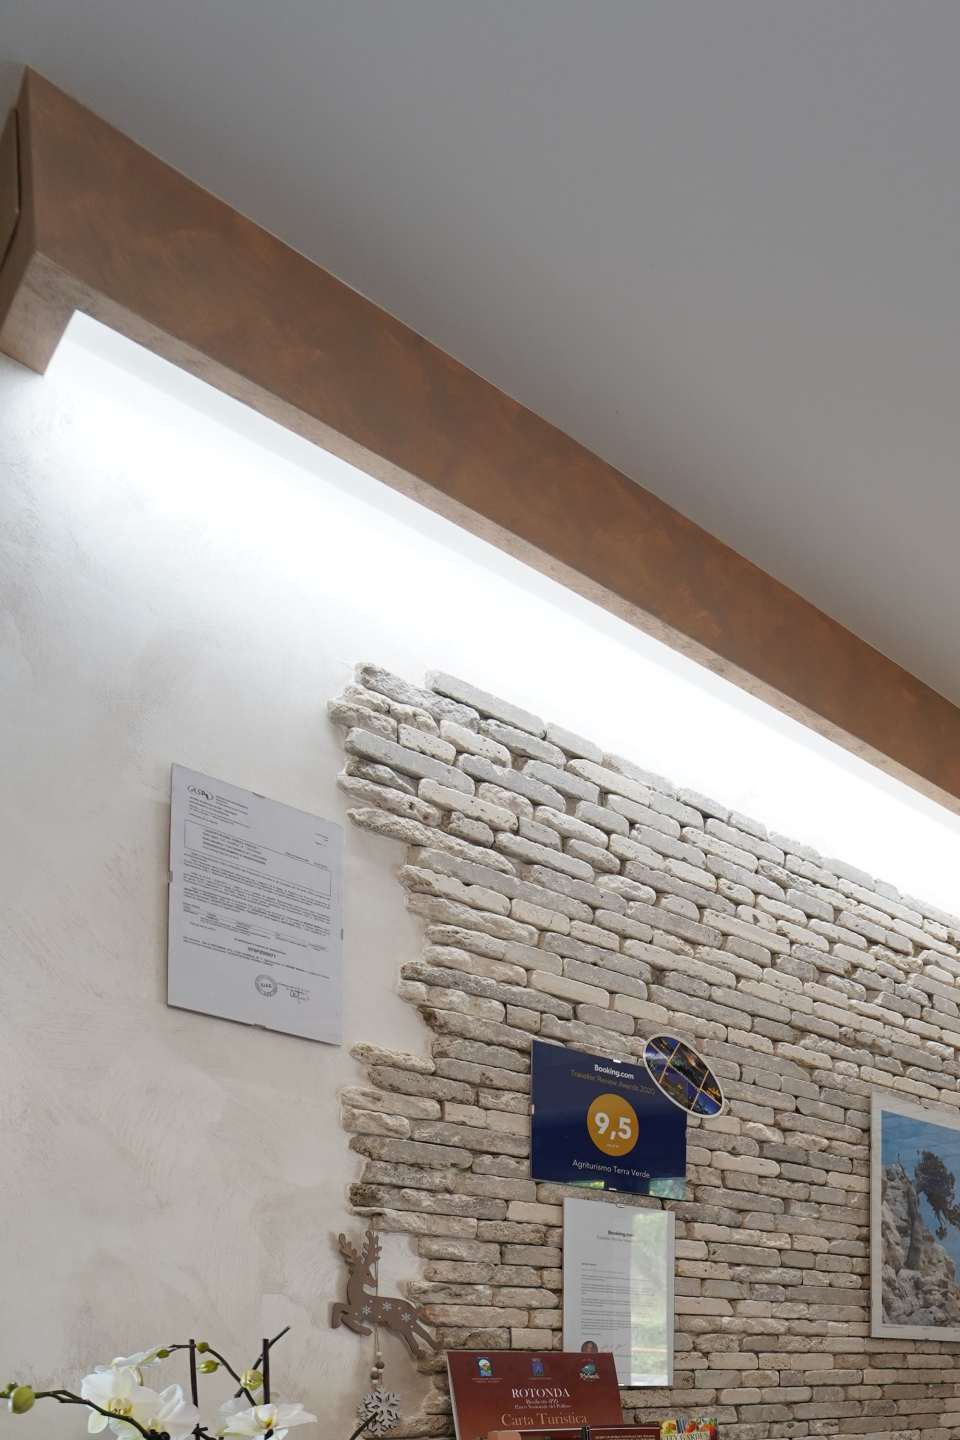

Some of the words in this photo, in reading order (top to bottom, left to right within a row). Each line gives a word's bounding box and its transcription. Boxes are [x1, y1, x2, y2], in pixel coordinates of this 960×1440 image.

[594, 1064, 634, 1079] Booking.com
[594, 1112, 632, 1140] 9,5
[572, 1160, 611, 1172] Agriturismo
[612, 1166, 629, 1175] Terra
[631, 1169, 650, 1178] Verde
[512, 1388, 570, 1399] ROTONDA
[501, 1413, 534, 1426] Carta
[536, 1412, 588, 1425] Turistica
